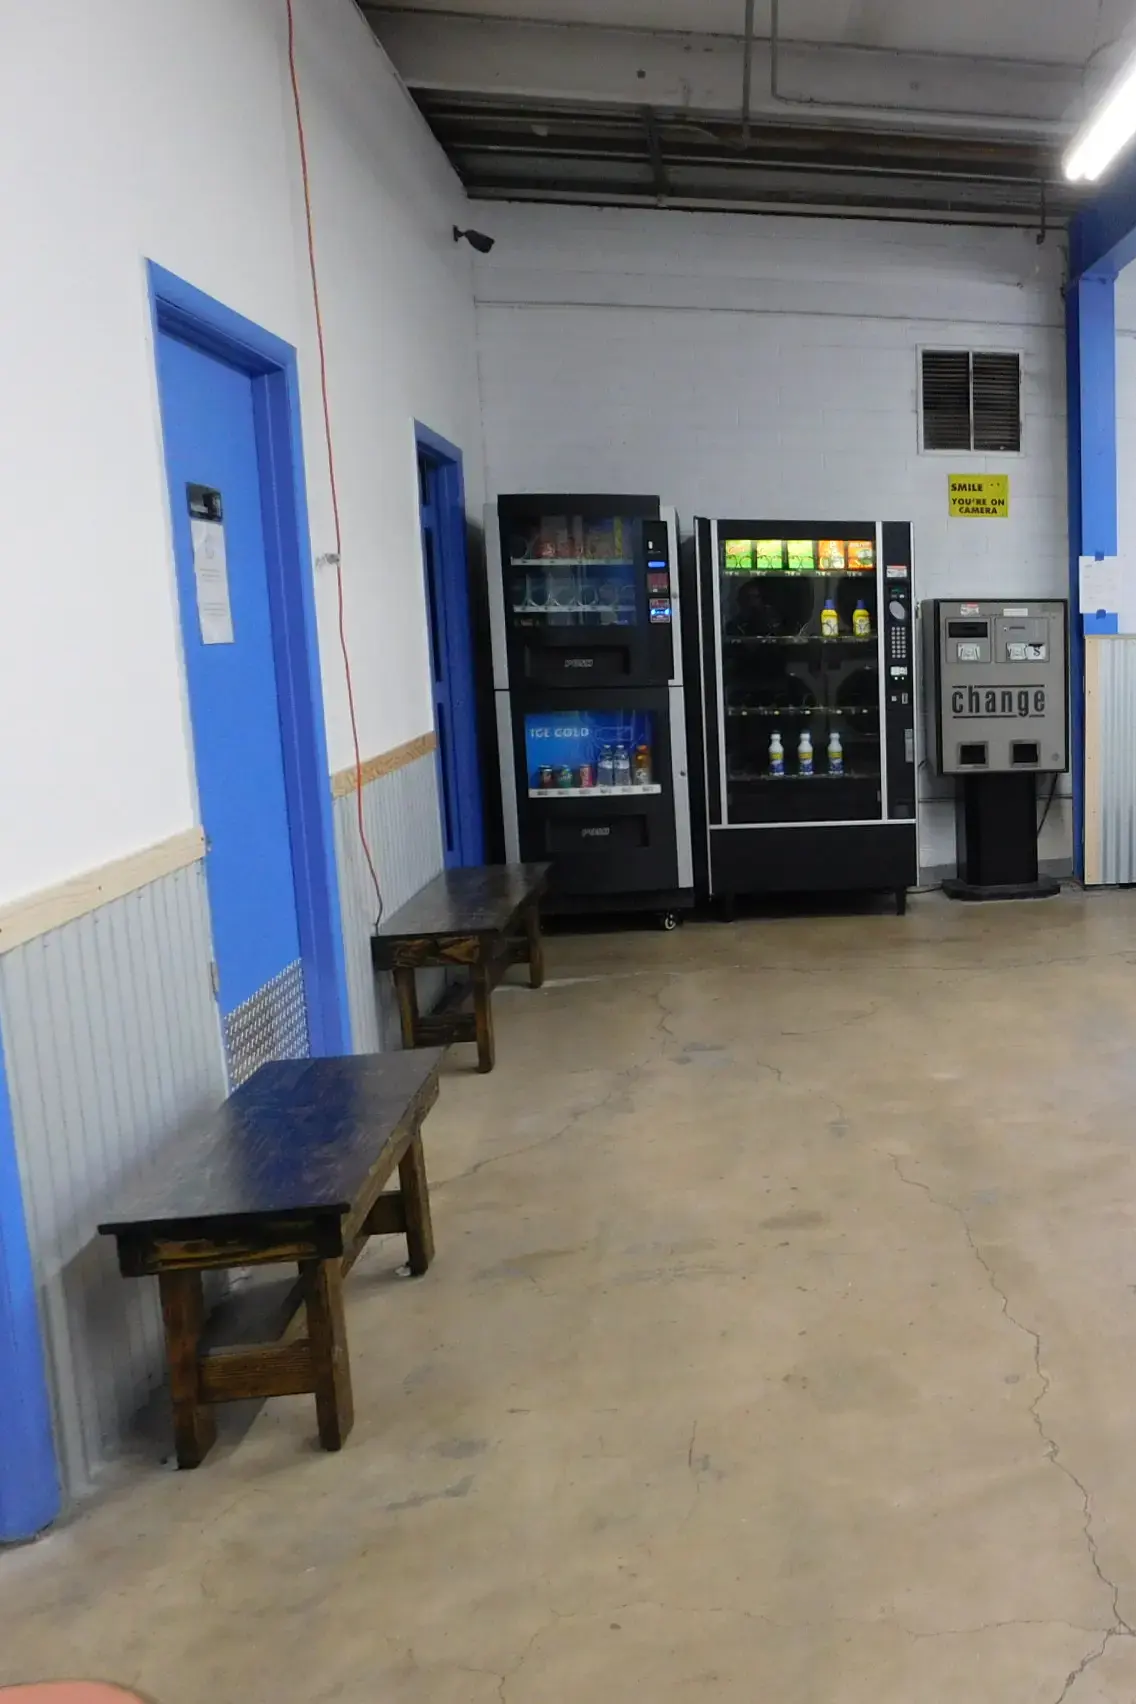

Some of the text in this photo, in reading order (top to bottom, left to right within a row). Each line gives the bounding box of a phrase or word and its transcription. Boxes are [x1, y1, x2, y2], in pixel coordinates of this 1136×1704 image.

[951, 483, 983, 492] SMILE
[952, 498, 1005, 506] YOU'RE ON
[959, 506, 998, 514] CAMERA
[951, 685, 1046, 718] change
[554, 727, 590, 738] COLD
